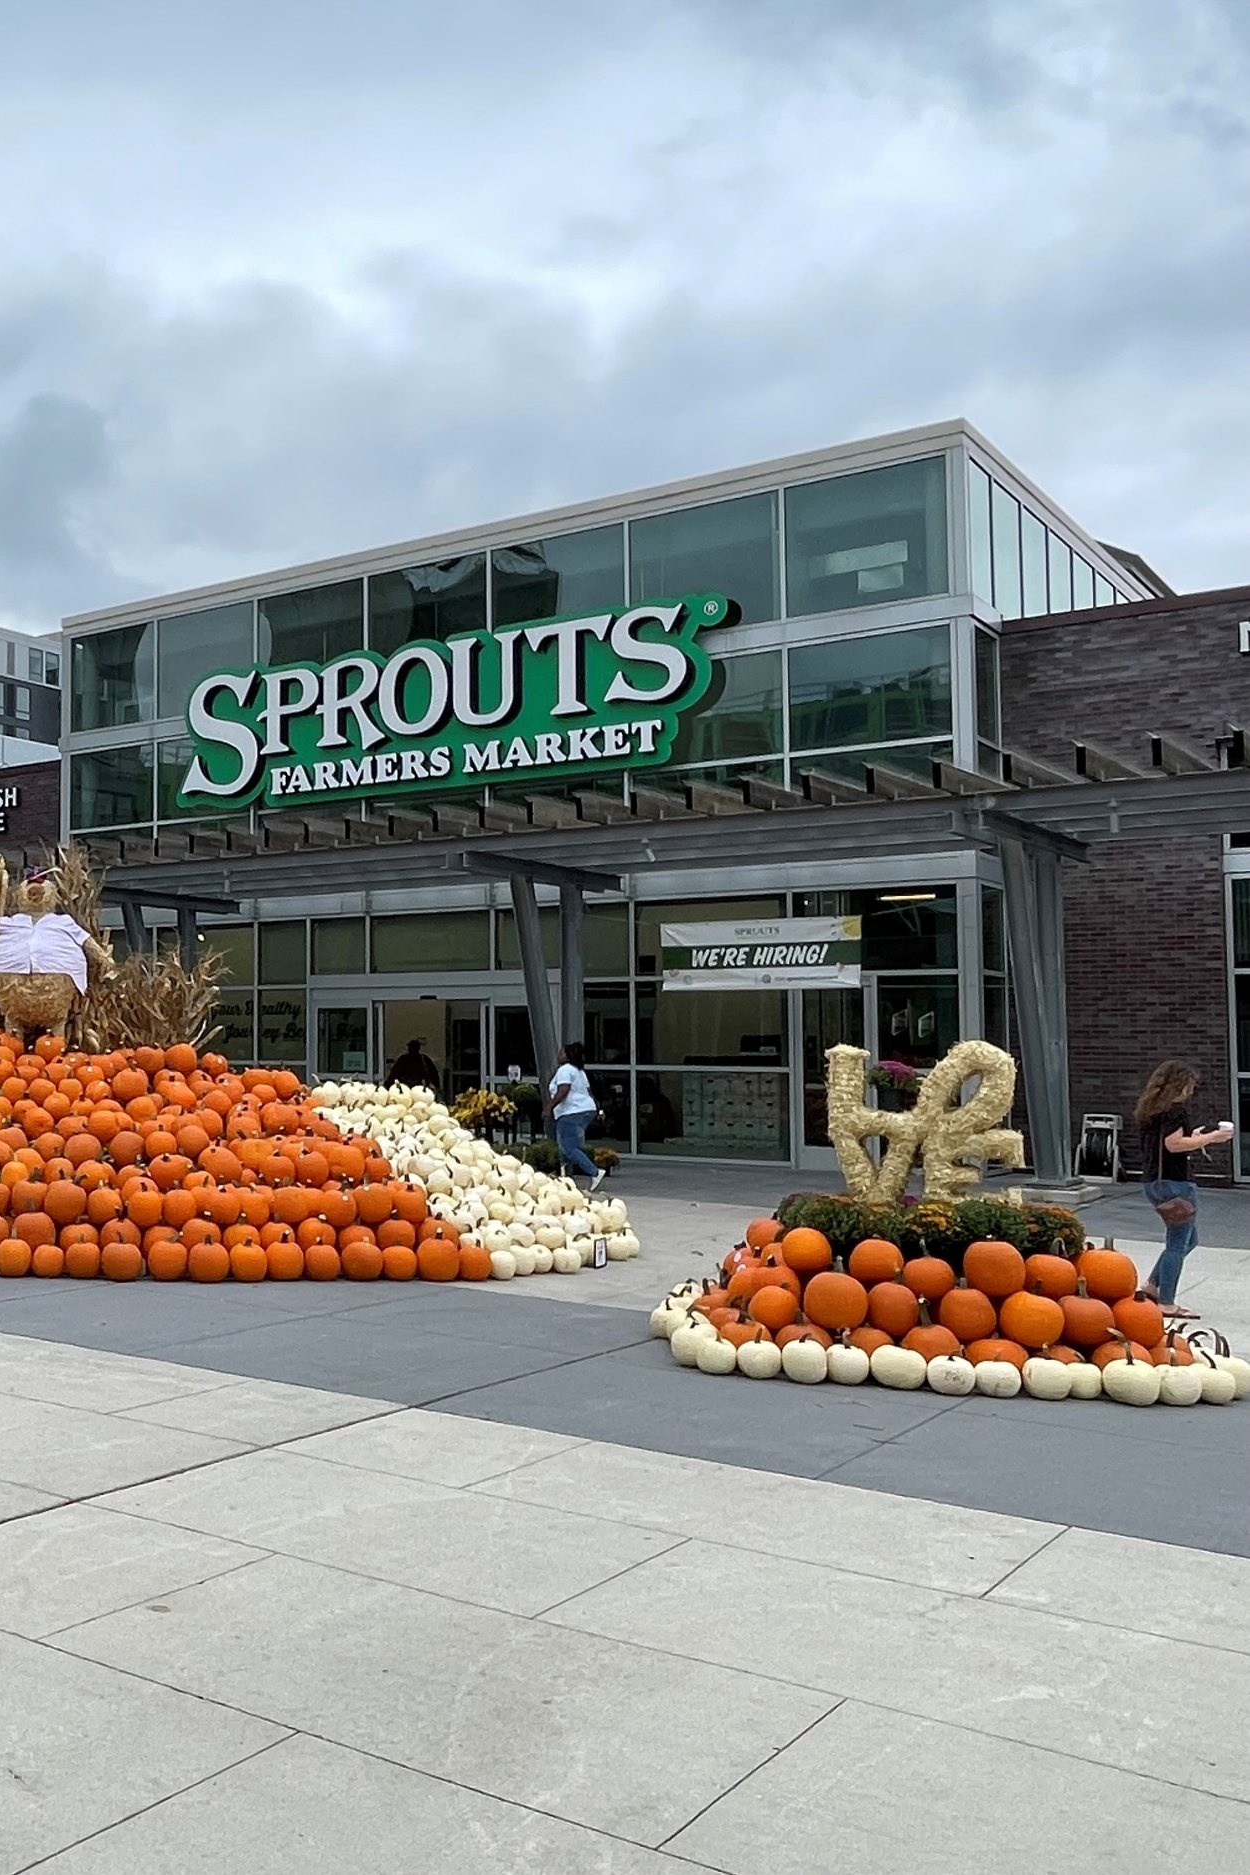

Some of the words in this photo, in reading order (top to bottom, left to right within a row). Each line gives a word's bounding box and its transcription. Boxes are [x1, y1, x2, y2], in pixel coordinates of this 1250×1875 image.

[182, 602, 688, 797] SPROUTS
[270, 746, 450, 796] FARMERS
[462, 719, 663, 774] MARKET
[691, 946, 749, 968] WE'RE
[753, 944, 829, 966] HIRING!
[734, 926, 780, 936] SPROUTS
